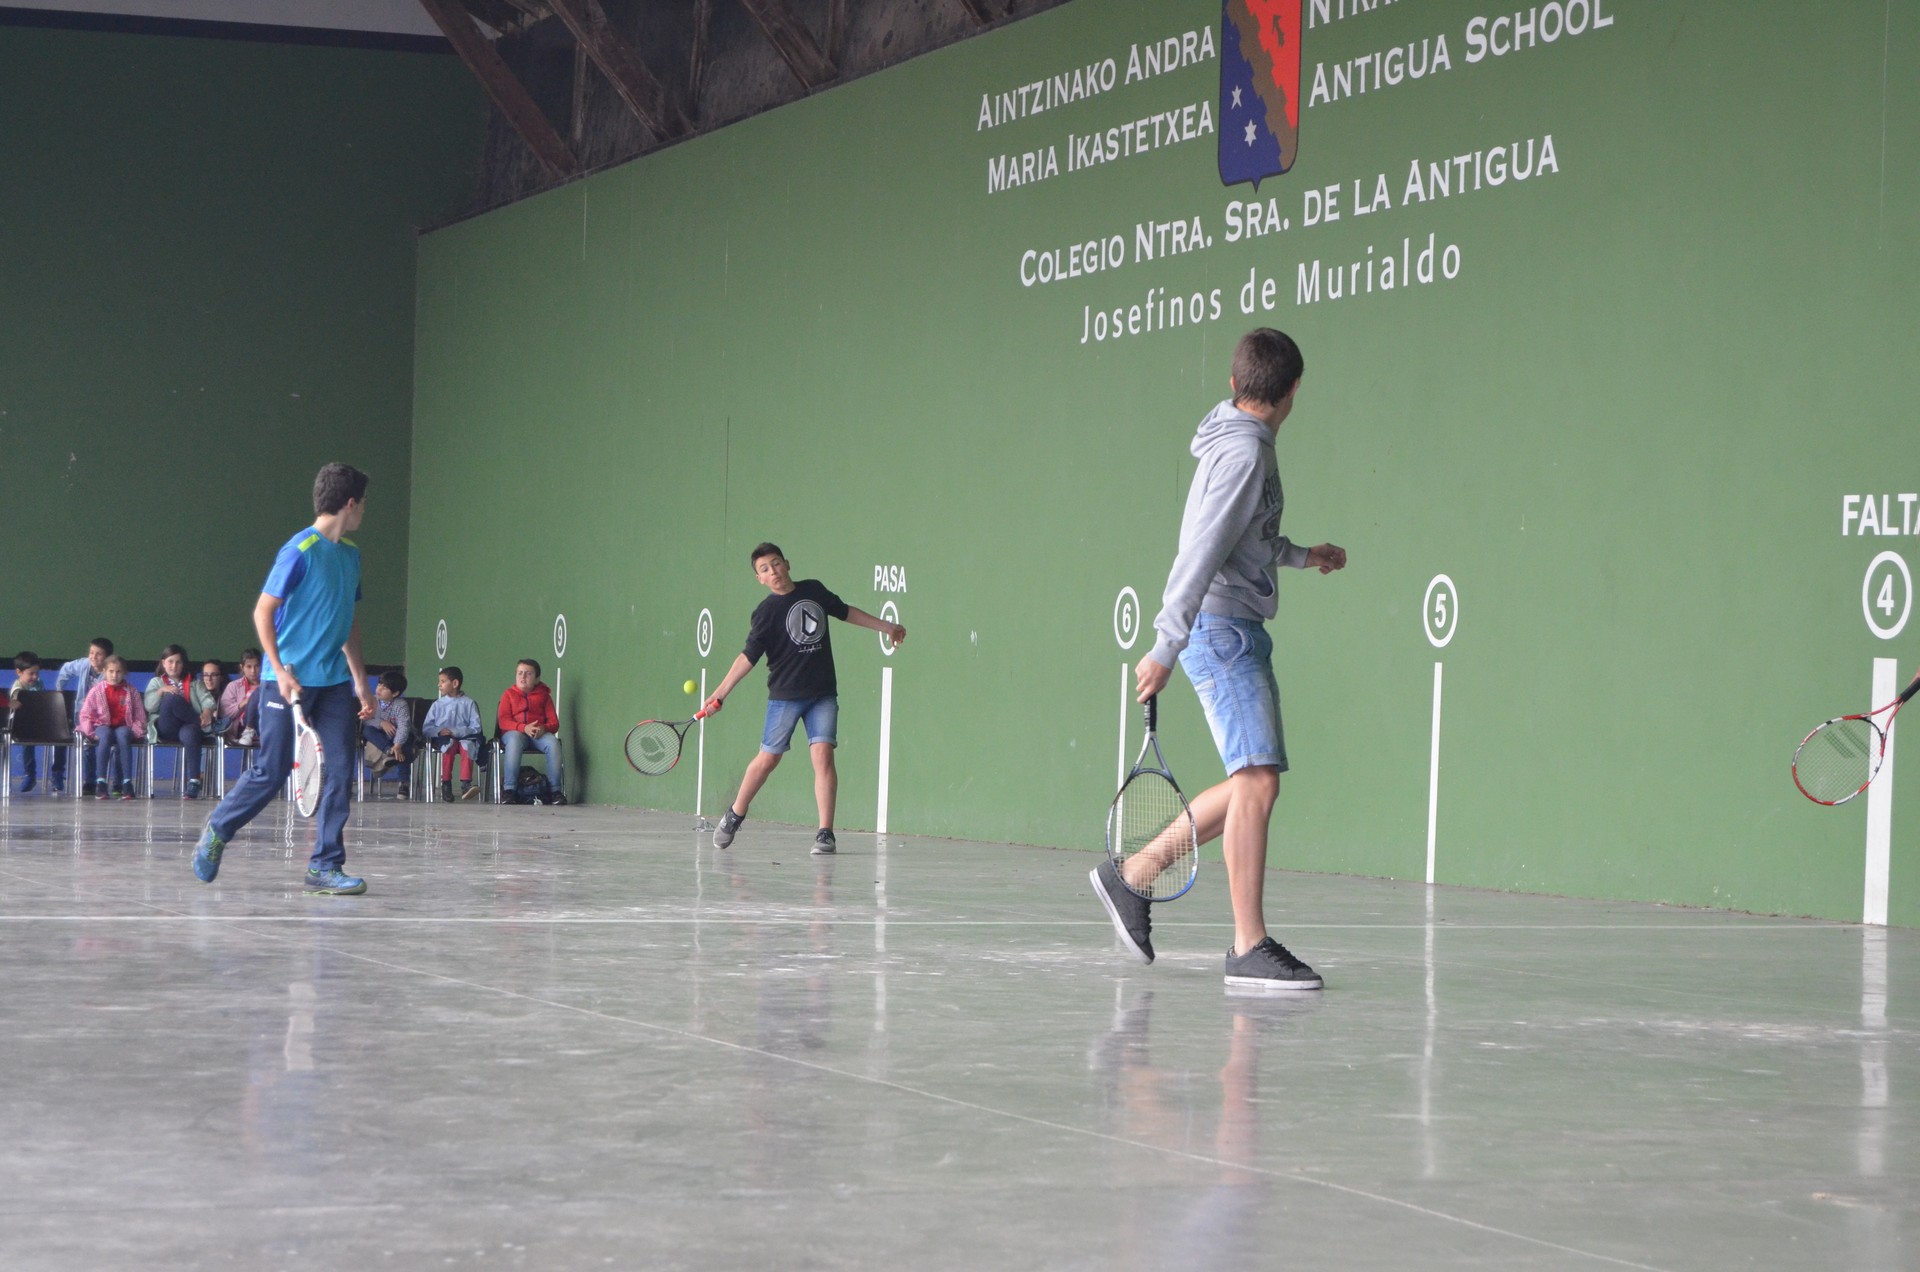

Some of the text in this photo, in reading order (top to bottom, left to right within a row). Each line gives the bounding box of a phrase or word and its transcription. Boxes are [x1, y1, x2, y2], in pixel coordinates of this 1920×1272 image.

[1308, 0, 1614, 108] ANTIGUA SCHOOL
[976, 25, 1216, 131] AINTZINAKO ANDRA
[987, 100, 1215, 194] MARIA IKASTETXEA
[1019, 133, 1560, 288] COLEGIO NTRA. SRA. DE LA ANTIGUA
[1080, 230, 1462, 344] Josefinos de Murialdo
[873, 564, 907, 593] PASA
[1876, 573, 1895, 617] 4
[701, 620, 708, 645] 8
[1121, 602, 1132, 634] 6
[1433, 593, 1447, 629] 5
[557, 625, 563, 648] 9
